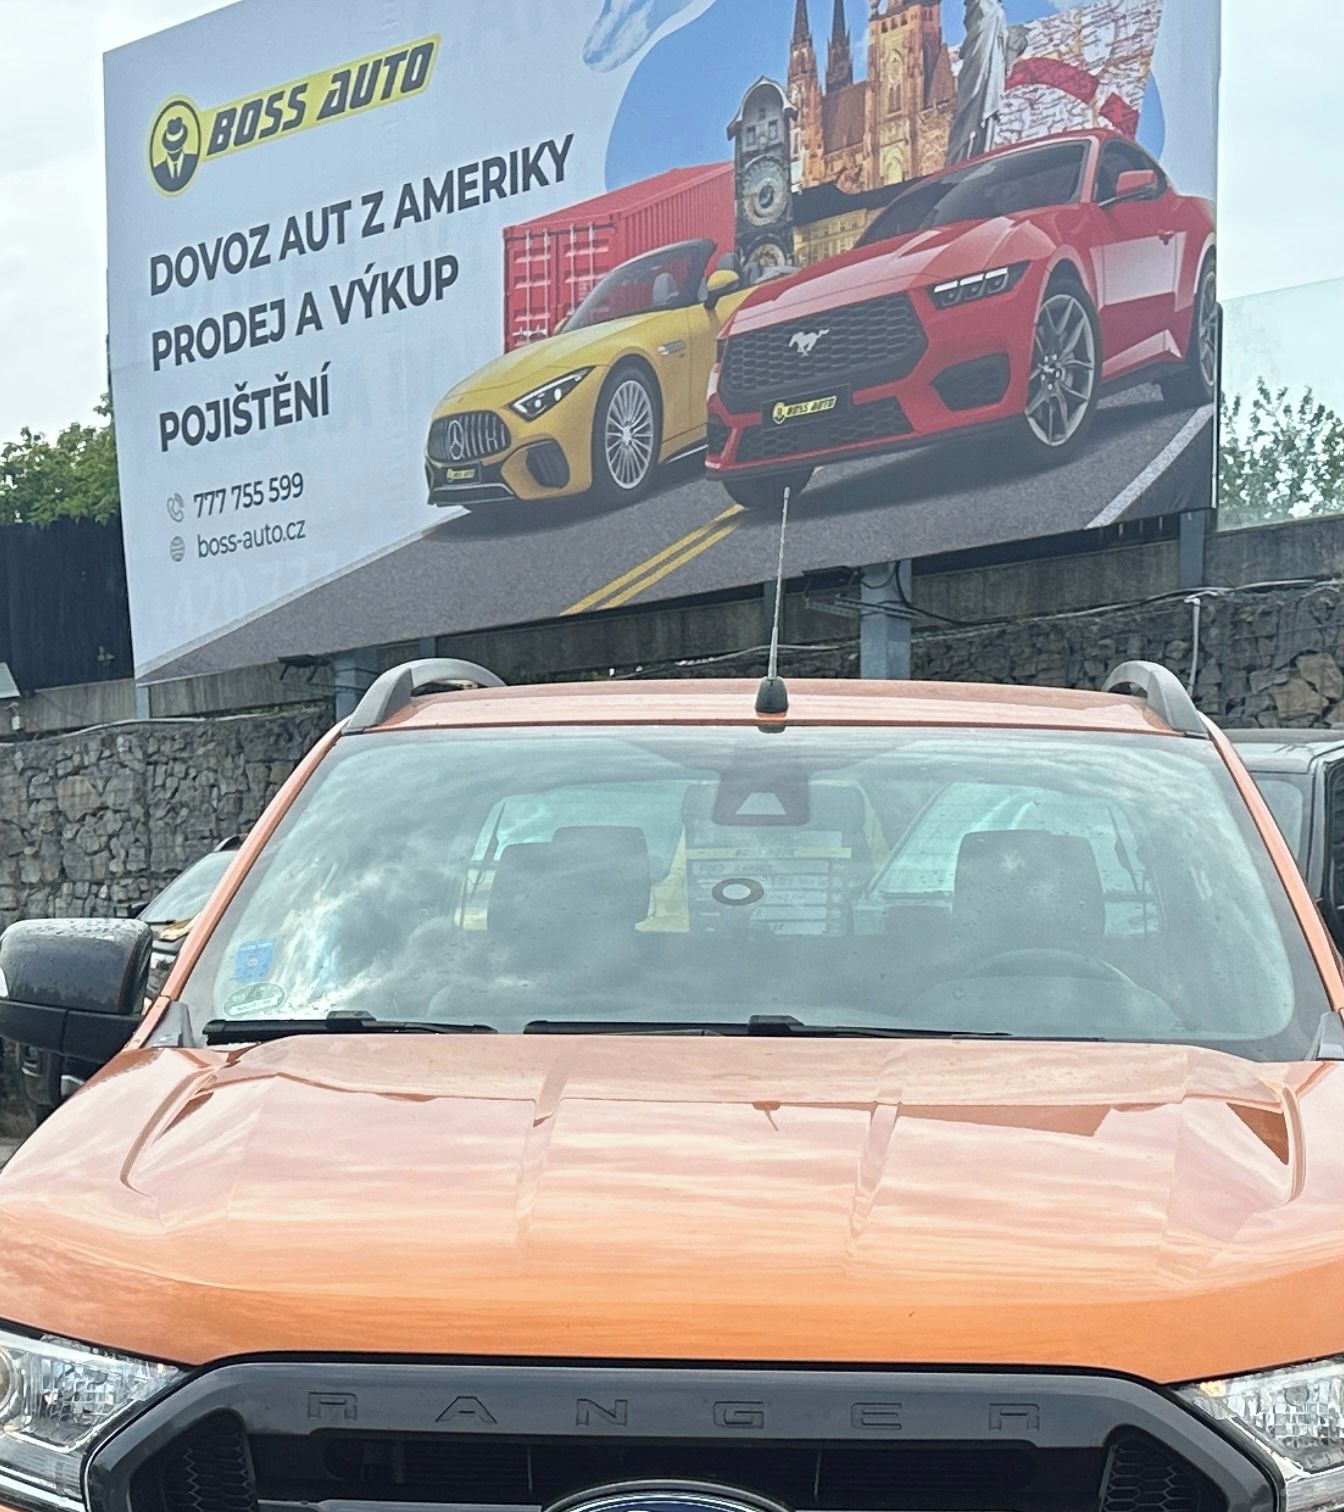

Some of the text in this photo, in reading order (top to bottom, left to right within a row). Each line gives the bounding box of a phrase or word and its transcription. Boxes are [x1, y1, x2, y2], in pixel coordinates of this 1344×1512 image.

[207, 42, 435, 157] BOSS AUTO
[150, 134, 575, 296] DOVOZ AUT Z AMERIKY
[152, 254, 460, 372] PRODEJ A VÝKUP
[159, 361, 332, 452] POJIŠTĚNÍ
[193, 472, 304, 518] 777 755 599
[197, 519, 306, 558] boss-auto.cz
[306, 1391, 1041, 1432] RANGER
